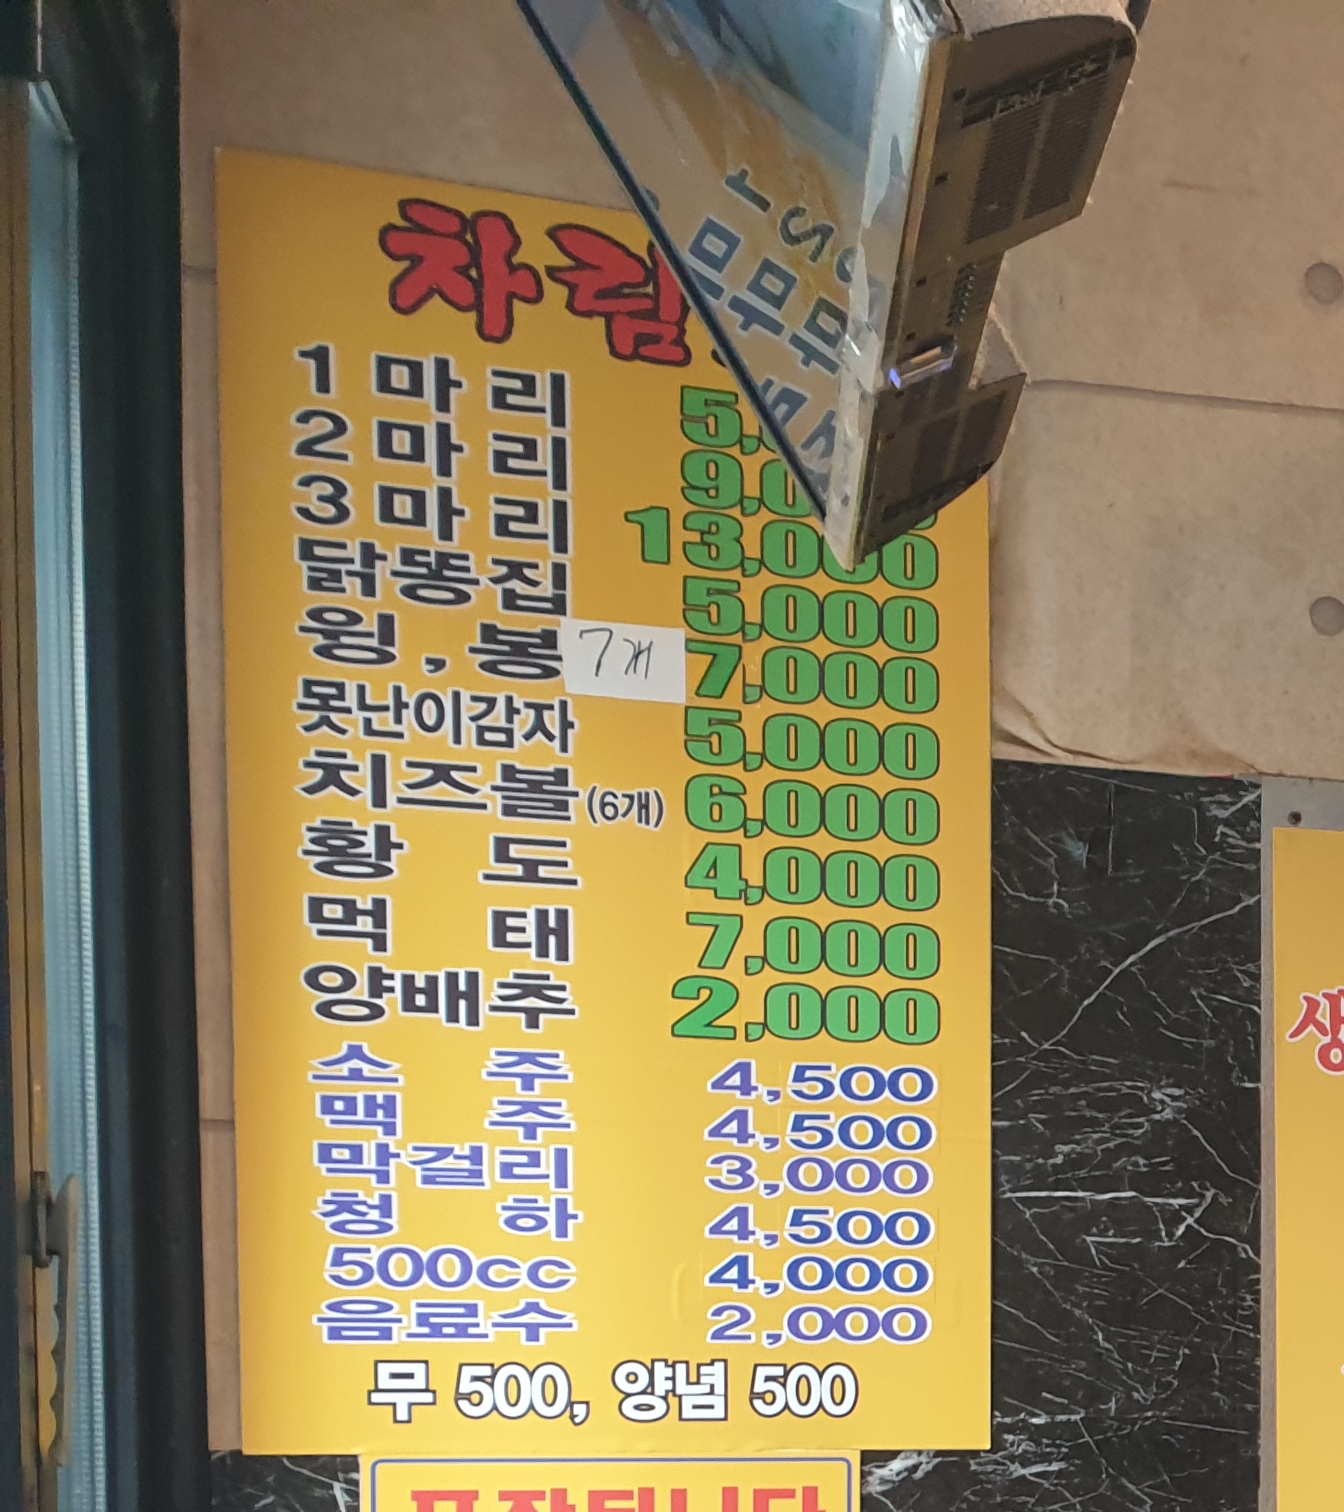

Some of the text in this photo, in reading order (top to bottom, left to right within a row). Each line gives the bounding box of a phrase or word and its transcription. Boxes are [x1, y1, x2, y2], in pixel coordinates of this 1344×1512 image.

[379, 198, 692, 367] 차림
[297, 536, 567, 617] 닭똥집
[683, 576, 939, 654] 5,000
[685, 639, 939, 714] 7,000
[296, 677, 575, 755] 못난이감자
[684, 705, 940, 780] 5,000
[685, 773, 940, 846] 6,000
[685, 842, 940, 912] 4,000
[686, 911, 941, 981] 7,000
[302, 963, 578, 1030] 양배추
[671, 975, 941, 1046] 2,000
[708, 1058, 938, 1104] 4,500
[704, 1106, 936, 1153] 4,500
[314, 1140, 572, 1190] 막걸리
[704, 1153, 934, 1198] 3,000
[704, 1203, 935, 1250] 4,500
[324, 1244, 576, 1291] 500cc
[705, 1253, 934, 1296] 4,000
[313, 1296, 577, 1345] 음료수
[706, 1302, 933, 1348] 2,000
[367, 1359, 859, 1426] 무 500, 양념 500
